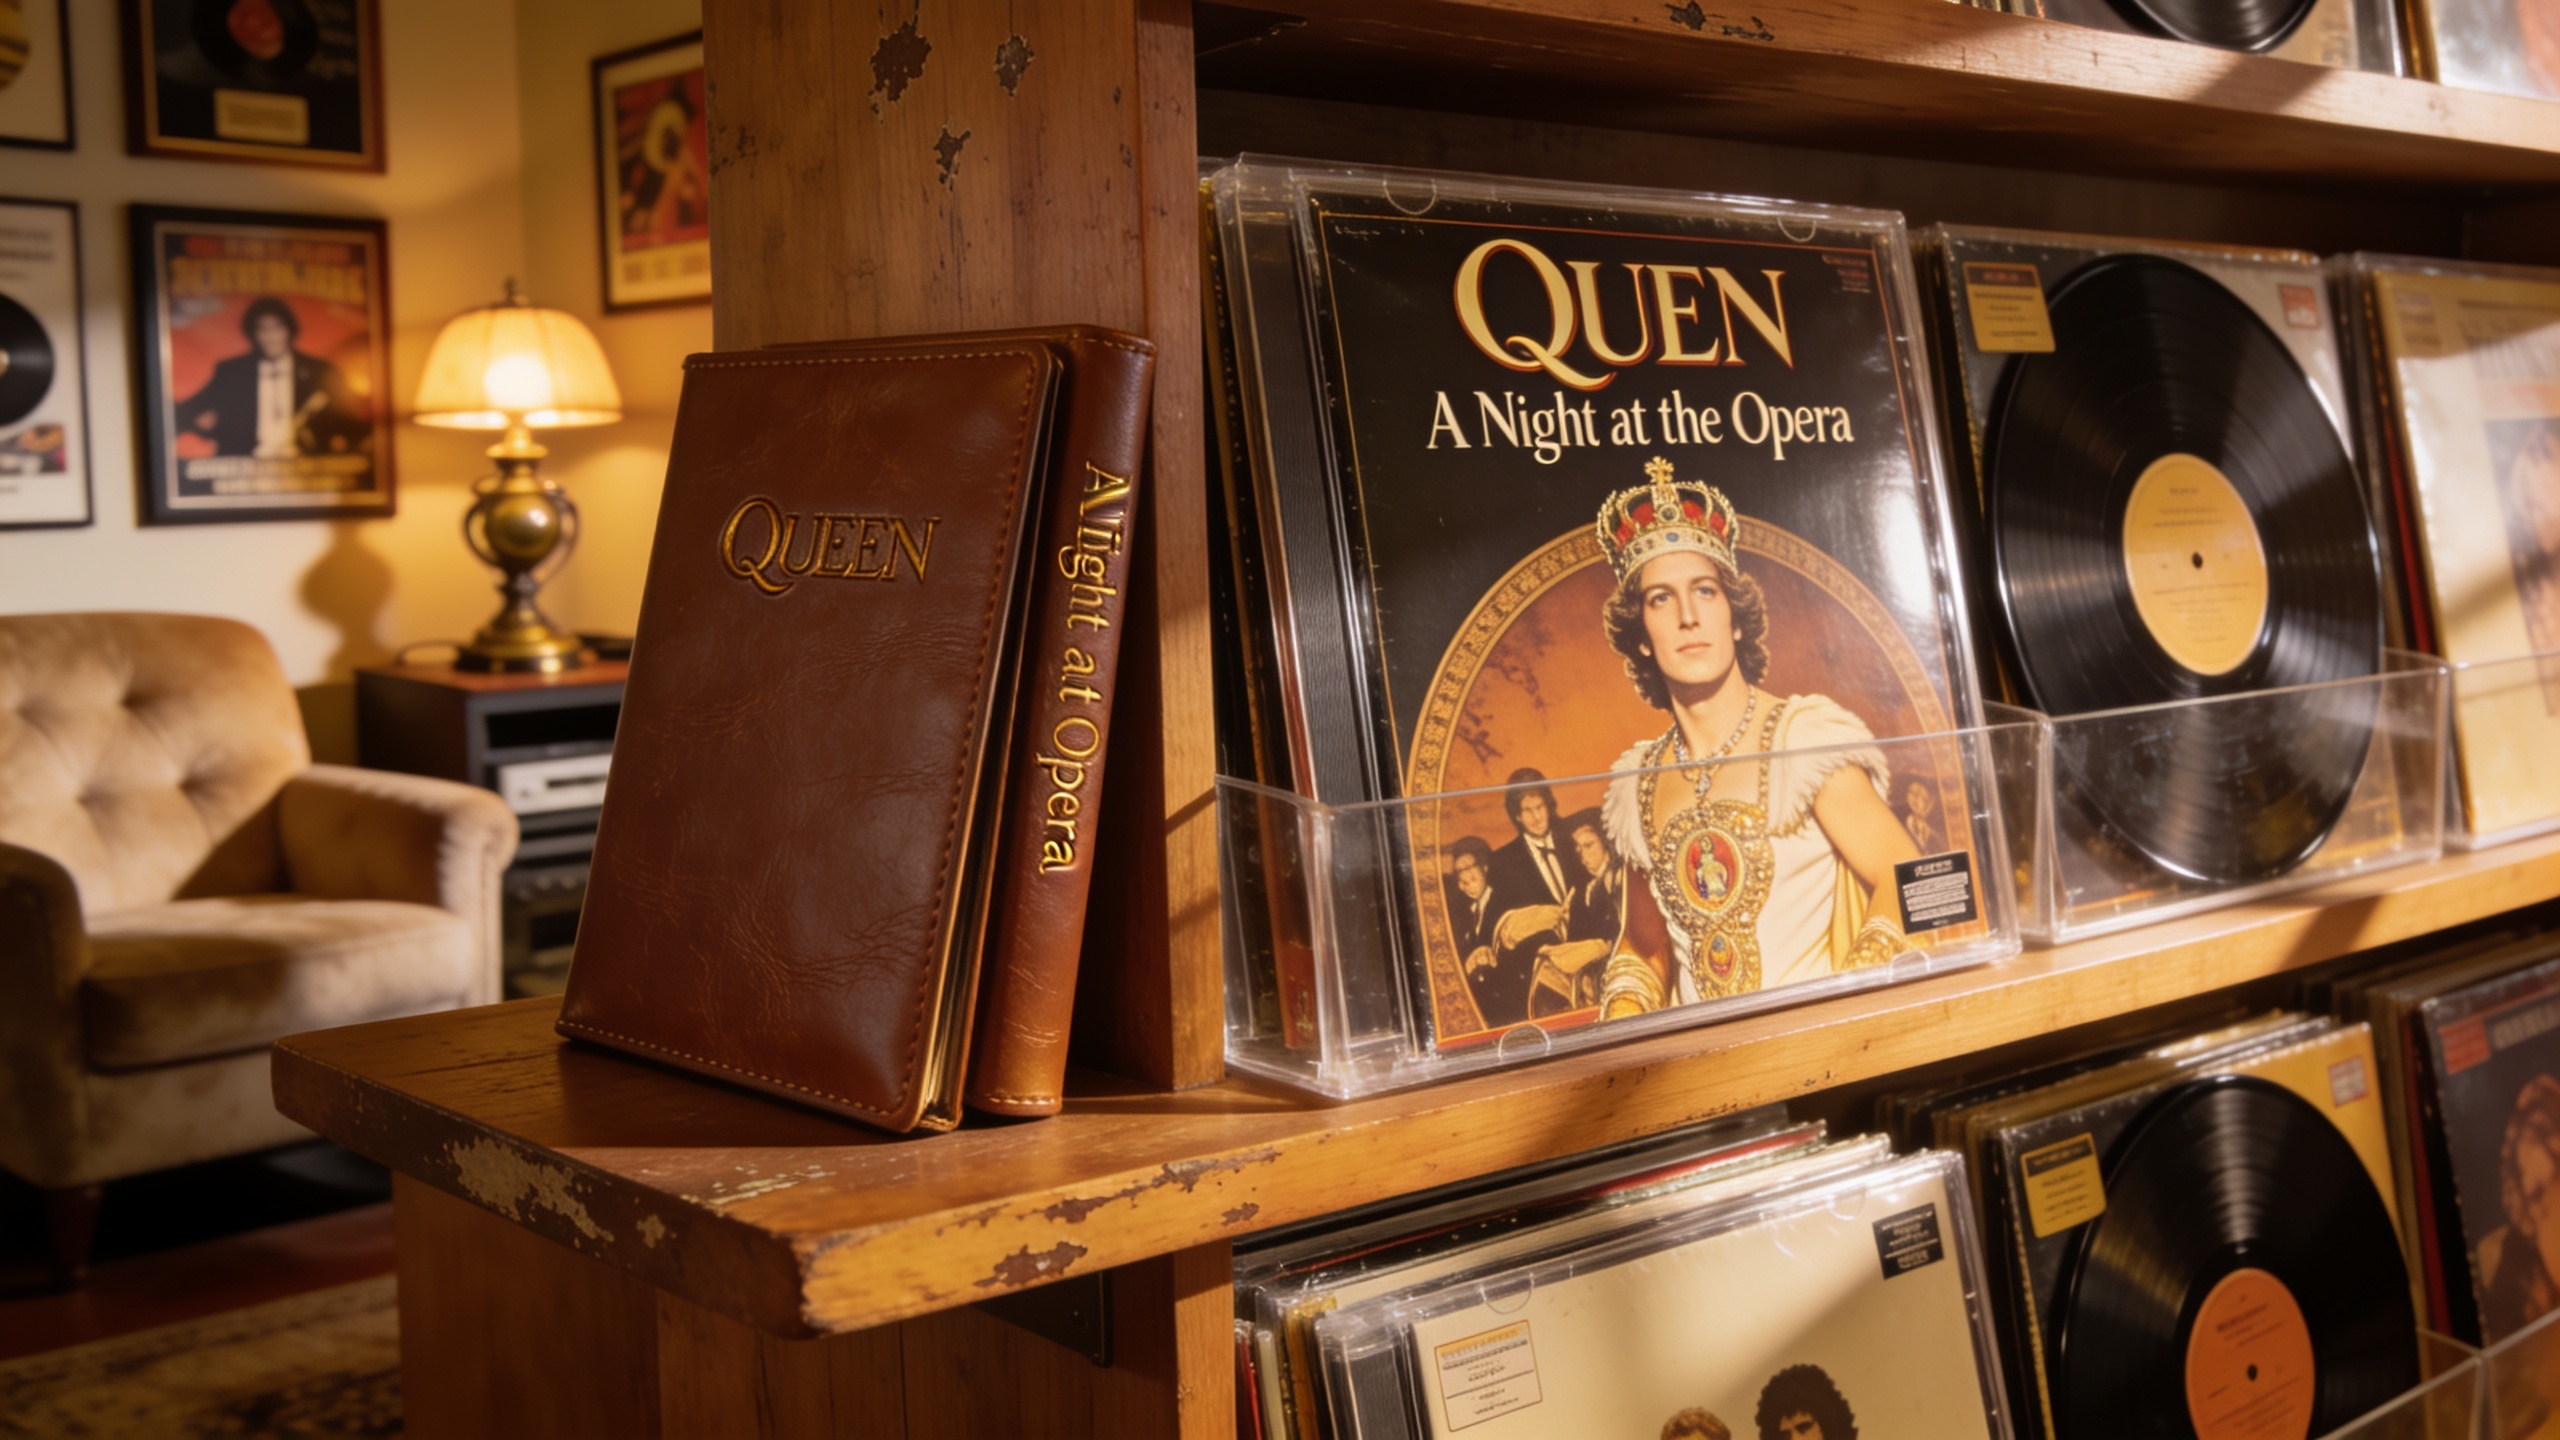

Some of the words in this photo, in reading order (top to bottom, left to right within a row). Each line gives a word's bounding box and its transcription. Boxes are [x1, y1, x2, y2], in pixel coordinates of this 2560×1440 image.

[1453, 238, 1794, 391] QUEN
[1426, 391, 1471, 449] A
[1473, 391, 1600, 464] Night
[1610, 399, 1651, 446] at
[1657, 389, 1723, 445] the
[1731, 391, 1855, 461] Opera
[720, 499, 942, 594] QUEEN
[1033, 716, 1100, 874] Opera
